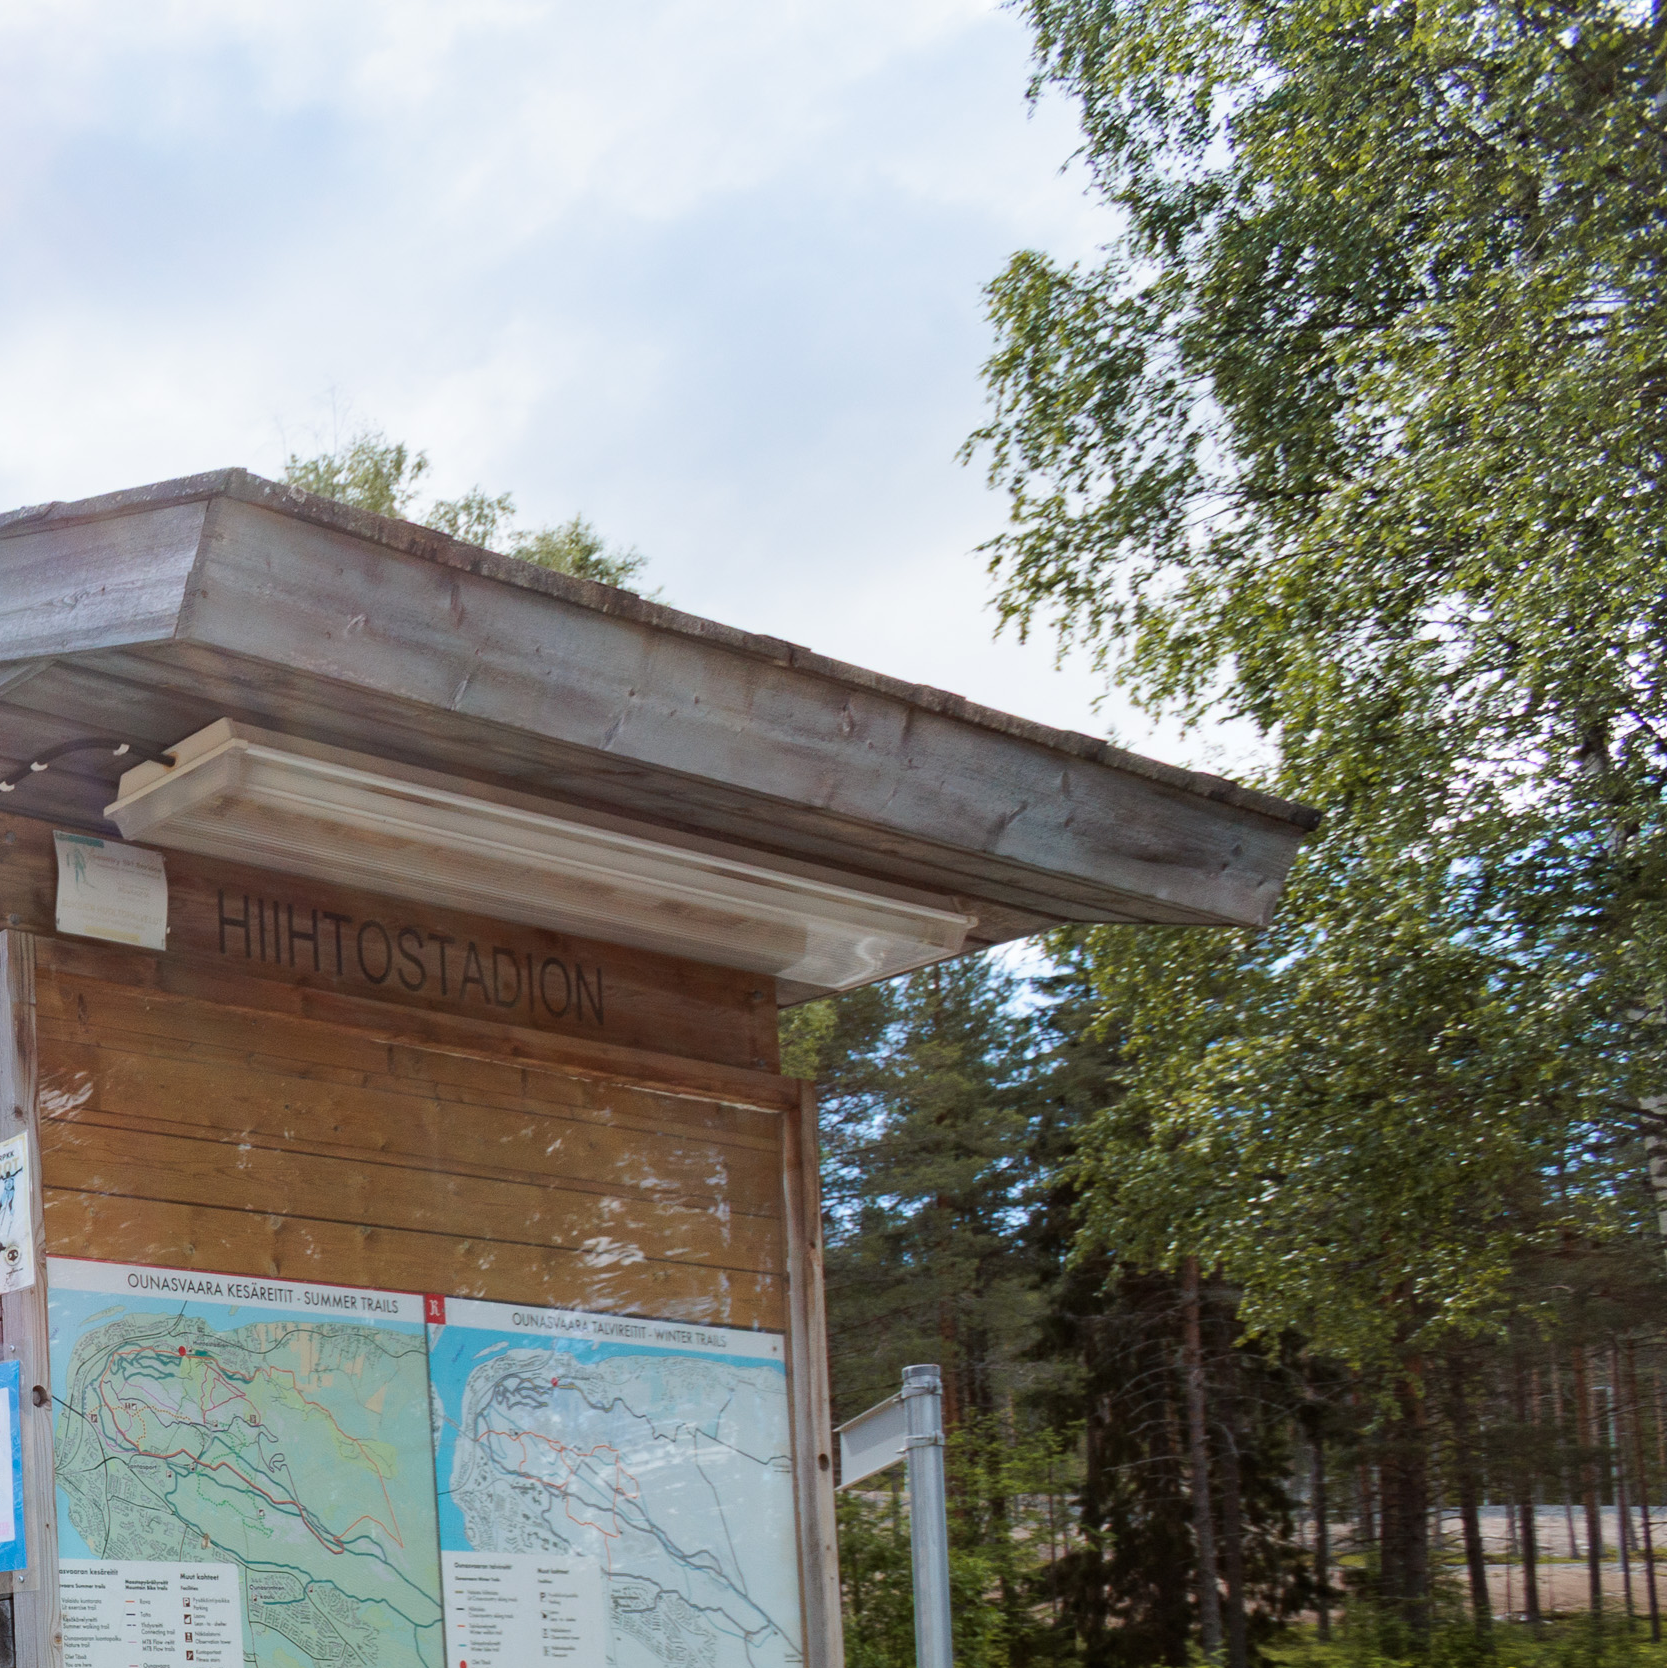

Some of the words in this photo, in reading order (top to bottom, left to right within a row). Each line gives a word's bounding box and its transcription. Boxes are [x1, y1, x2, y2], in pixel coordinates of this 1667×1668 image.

[216, 888, 605, 1026] HIIHTOSTADION
[127, 1273, 224, 1297] OUNASVAARA
[227, 1282, 293, 1304] KESÄREITIT
[304, 1290, 357, 1310] SUMMER
[360, 1296, 399, 1314] TRAILS
[512, 1312, 588, 1332] OUNASVAARA
[591, 1320, 646, 1339] TALVIREITIT
[654, 1327, 692, 1345] WINTER
[695, 1332, 727, 1348] TRAILS
